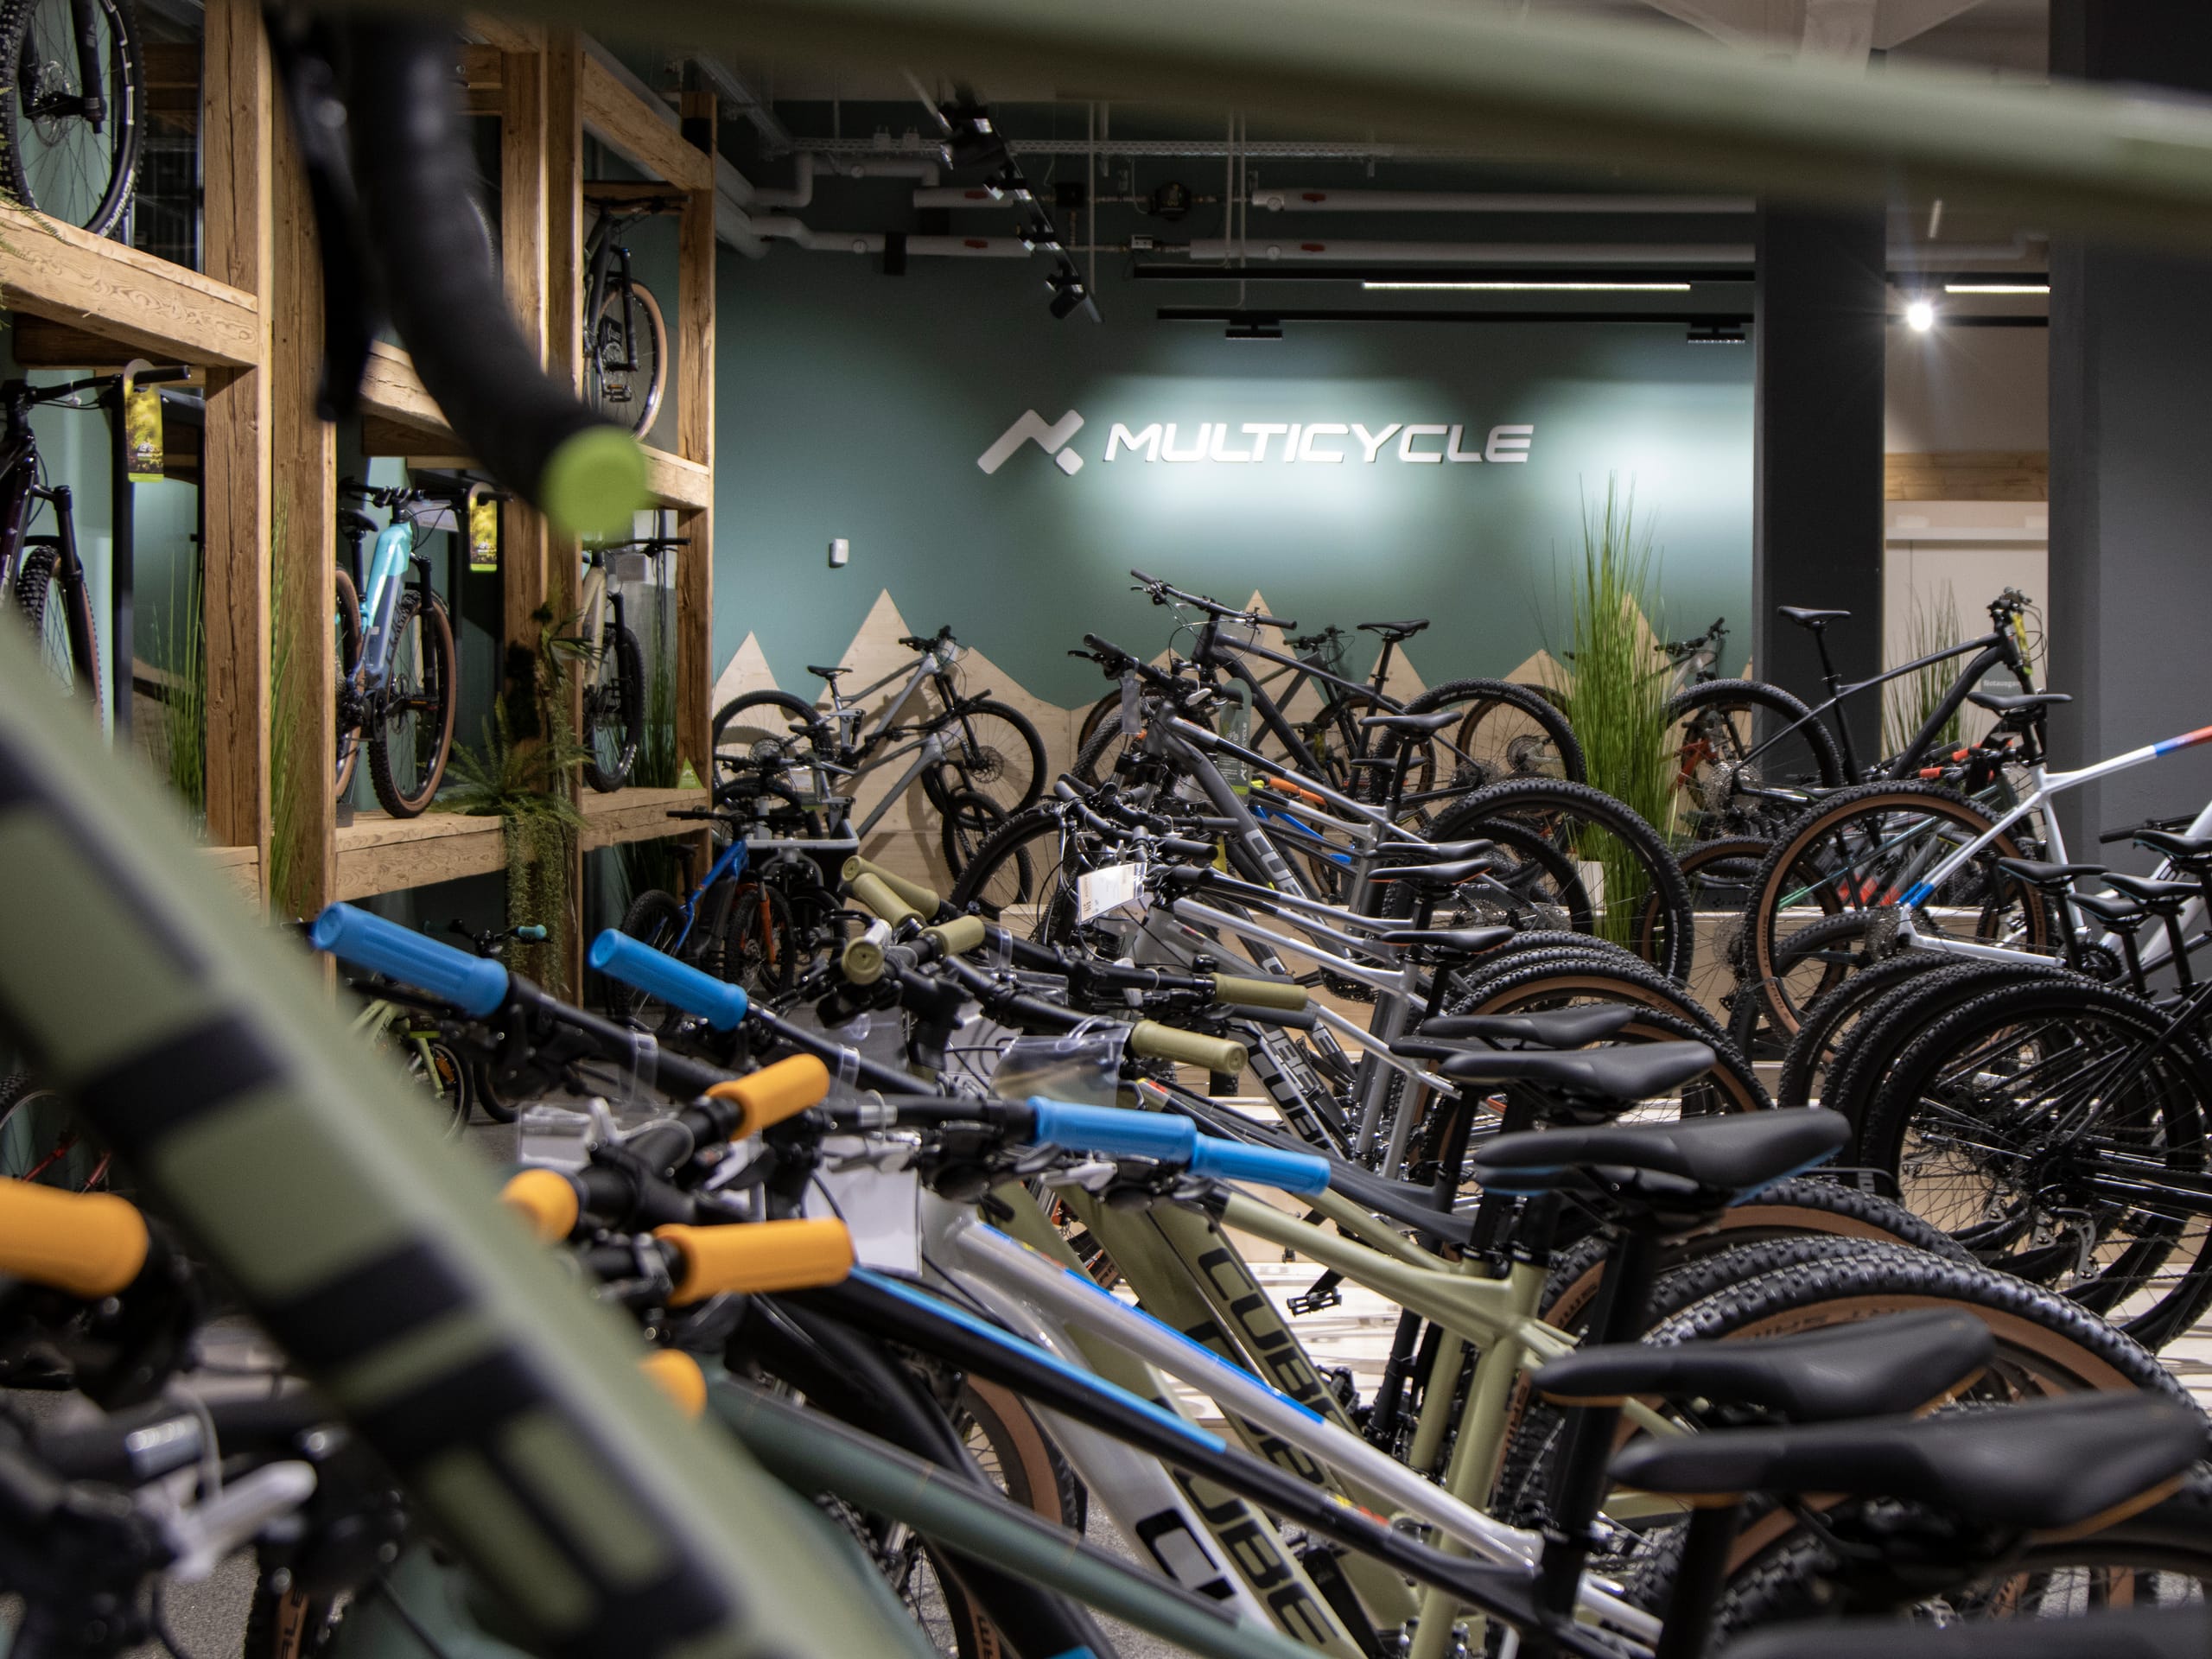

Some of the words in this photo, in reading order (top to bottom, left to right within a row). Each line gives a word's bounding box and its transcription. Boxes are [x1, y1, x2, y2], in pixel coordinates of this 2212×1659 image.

[98, 167, 137, 237] SCHWALB
[1103, 422, 1534, 462] MULTICYCLE
[1244, 829, 1308, 899] CUB
[1248, 1044, 1332, 1151] CUB
[1158, 1417, 1340, 1645] UBE
